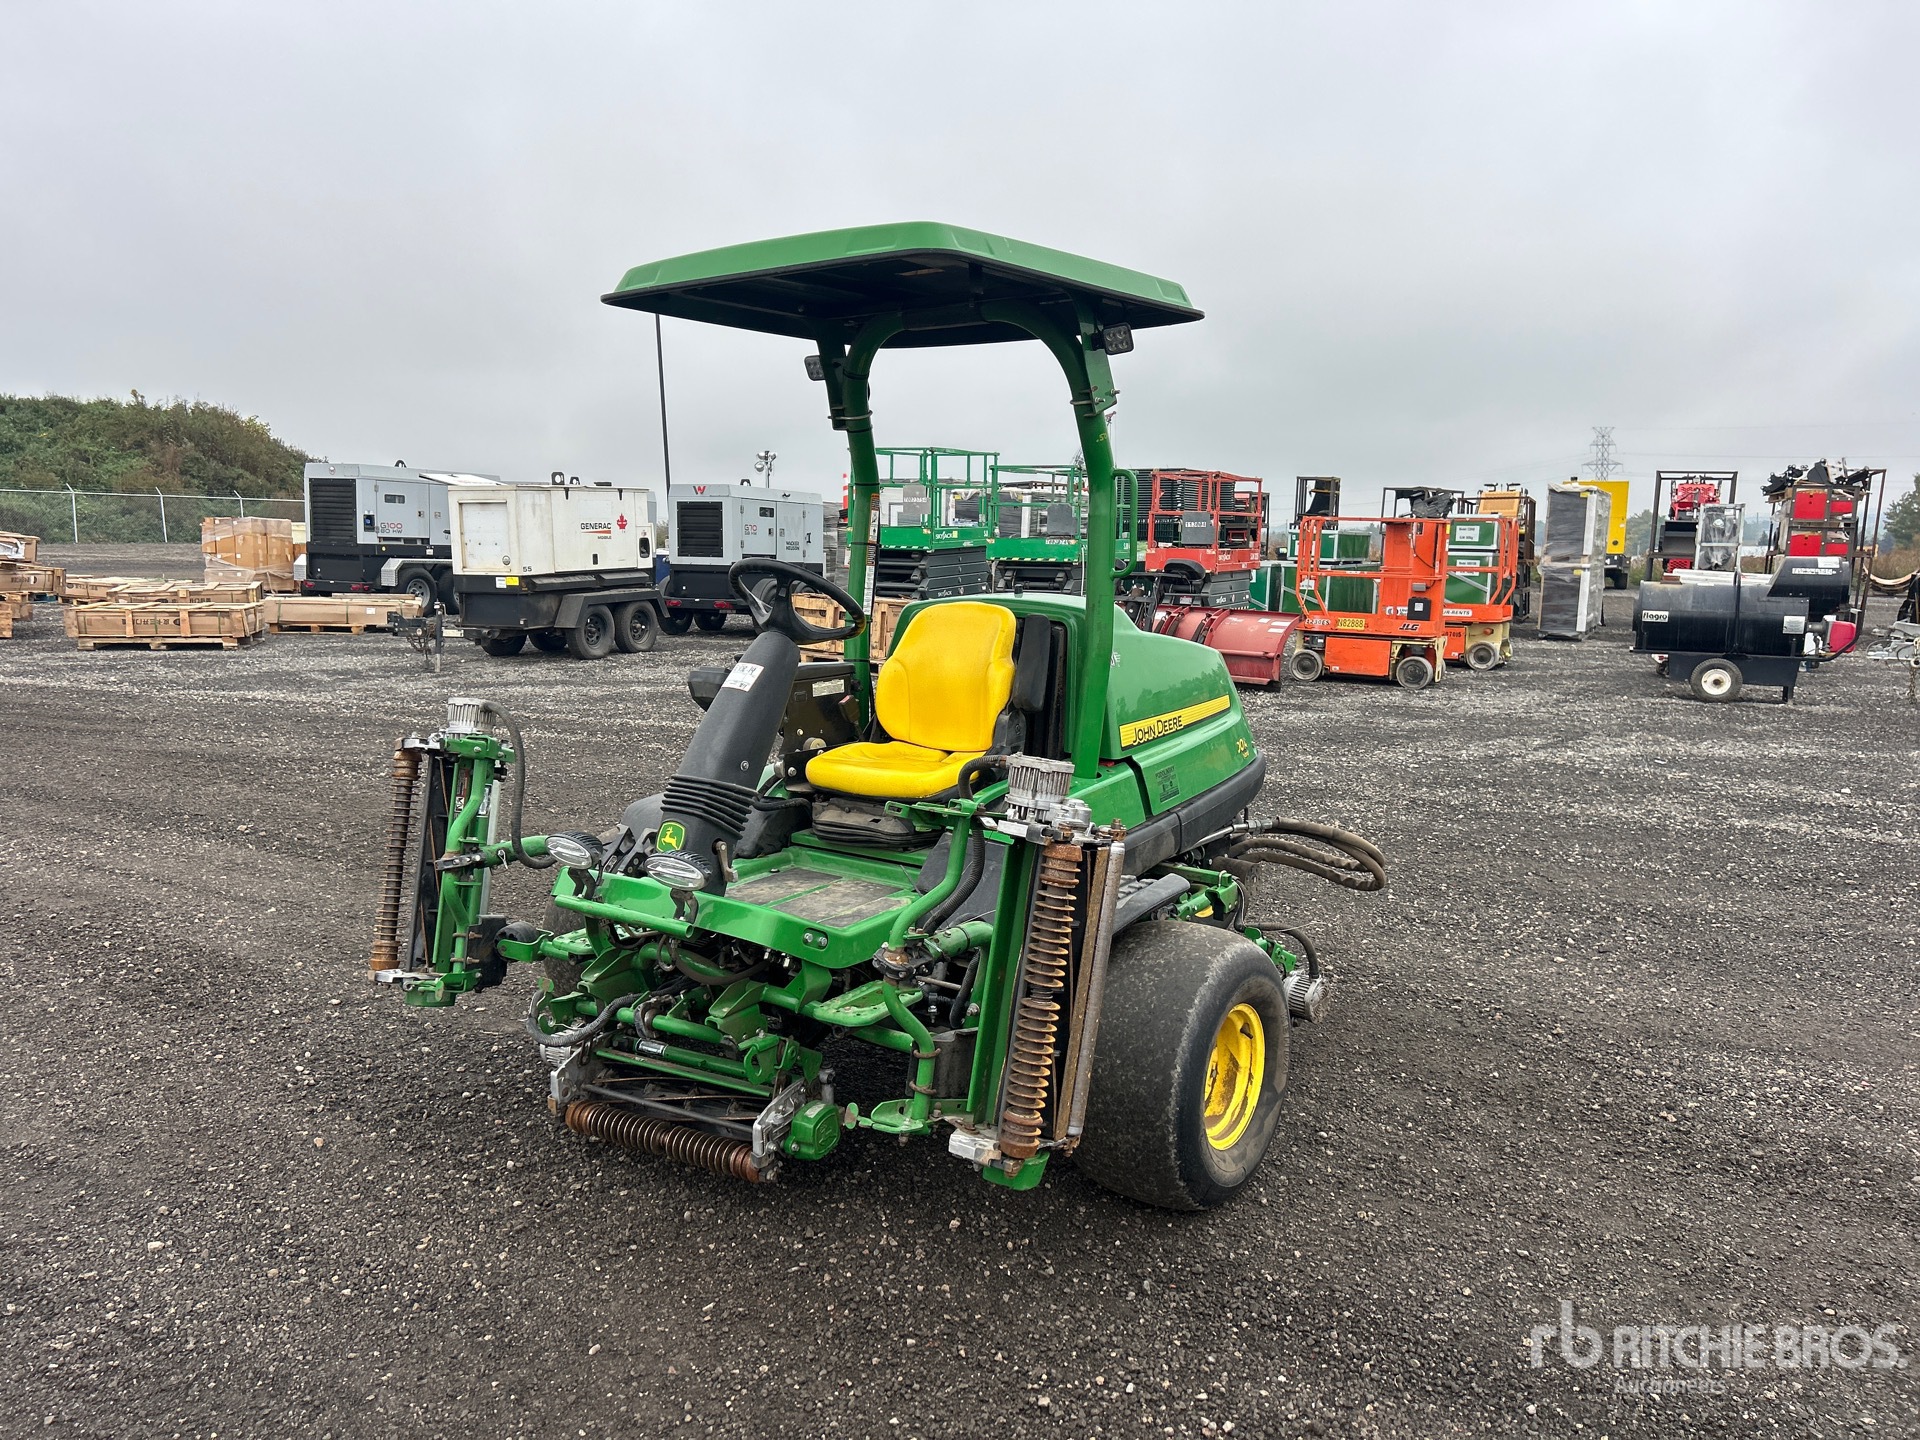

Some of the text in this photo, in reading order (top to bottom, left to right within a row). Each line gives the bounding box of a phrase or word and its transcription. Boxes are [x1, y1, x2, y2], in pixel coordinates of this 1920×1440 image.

[580, 522, 612, 530] GENERAC
[1642, 611, 1668, 621] flagro
[1398, 623, 1420, 632] JLG
[1132, 715, 1183, 744] JOHN DEERE
